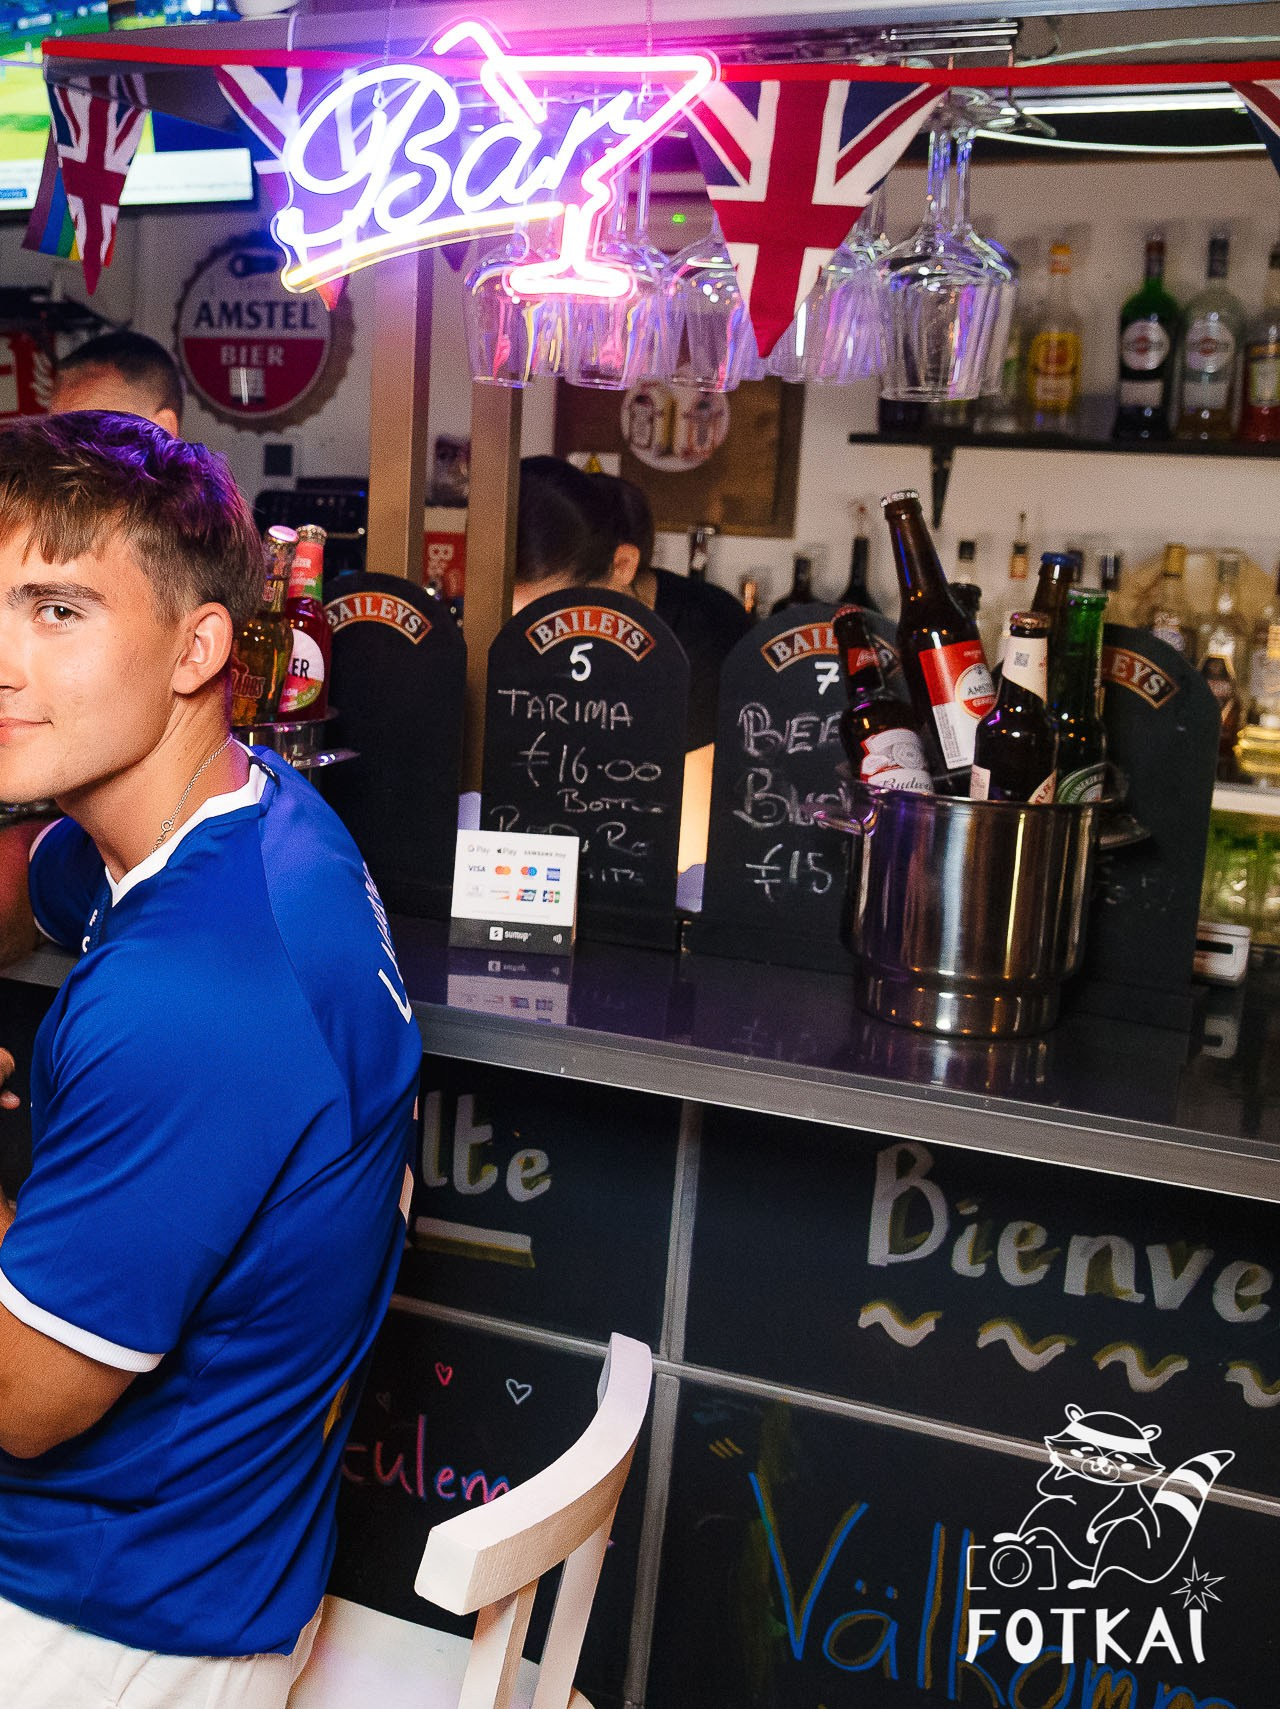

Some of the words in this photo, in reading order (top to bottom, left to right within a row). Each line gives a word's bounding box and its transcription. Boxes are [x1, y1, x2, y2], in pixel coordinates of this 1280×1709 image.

[277, 63, 638, 250] Bar
[193, 300, 317, 330] AMSTEL
[220, 345, 285, 367] BIER
[535, 610, 647, 650] BAILEYS
[569, 642, 593, 682] 5
[814, 661, 840, 695] 7
[498, 688, 633, 731] TARIMA
[468, 865, 486, 873] VISA
[867, 1142, 1274, 1324] Bienve
